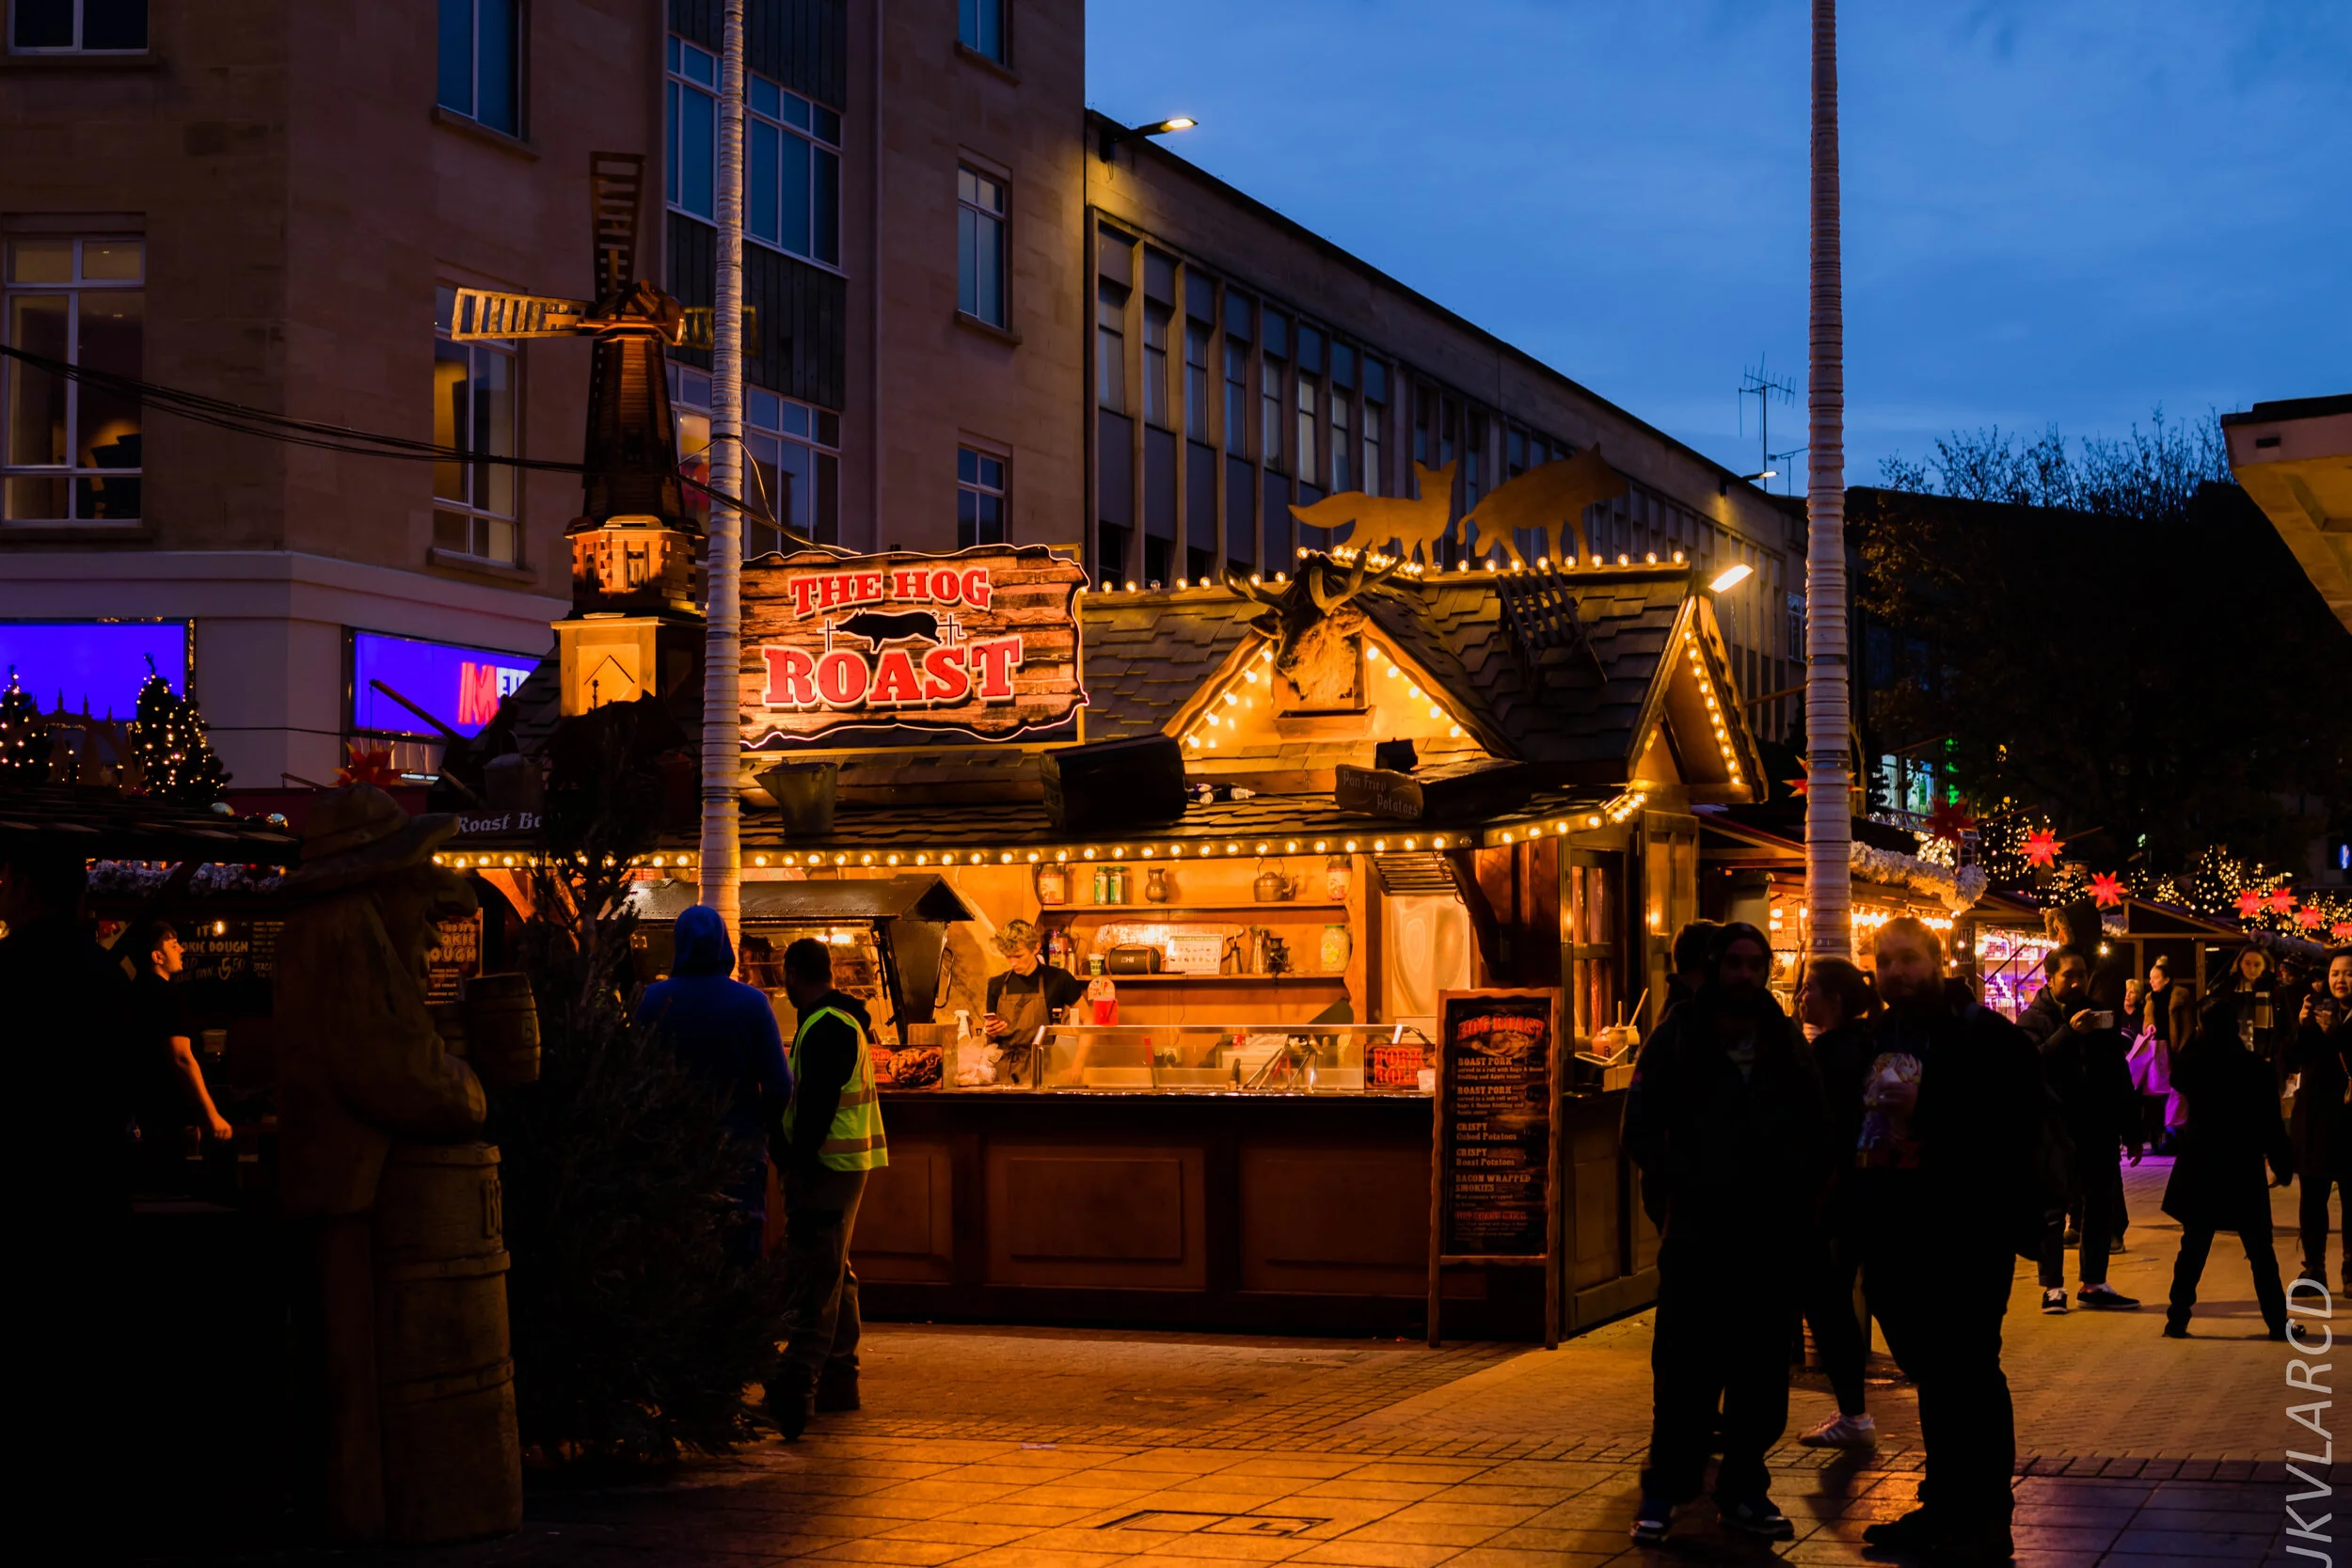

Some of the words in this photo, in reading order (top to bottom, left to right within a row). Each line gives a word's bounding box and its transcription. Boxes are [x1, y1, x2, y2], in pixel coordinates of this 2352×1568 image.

[788, 571, 882, 619] THE
[892, 568, 993, 610] HOG
[762, 636, 1024, 707] ROAST
[1343, 770, 1360, 787] Pan
[1376, 793, 1419, 816] Potatoes
[458, 813, 511, 833] Roast
[209, 941, 248, 953] DOUGH
[429, 946, 477, 962] OUGH
[1457, 1015, 1490, 1040] HOG
[1492, 1015, 1545, 1038] ROAST
[1375, 1048, 1423, 1066] PORK
[1457, 1057, 1486, 1066] ROAST
[1487, 1057, 1513, 1066] PORK
[1456, 1086, 1486, 1095] ROAST
[1487, 1085, 1512, 1094] PORK
[1456, 1122, 1487, 1132] CRISPY
[1483, 1132, 1517, 1141] Potatoes
[1455, 1148, 1486, 1157] CRISPY
[1455, 1158, 1479, 1166] Roast
[1481, 1158, 1516, 1166] Potatoes
[1455, 1174, 1485, 1182] BACON
[1486, 1174, 1531, 1182] WRAPPED
